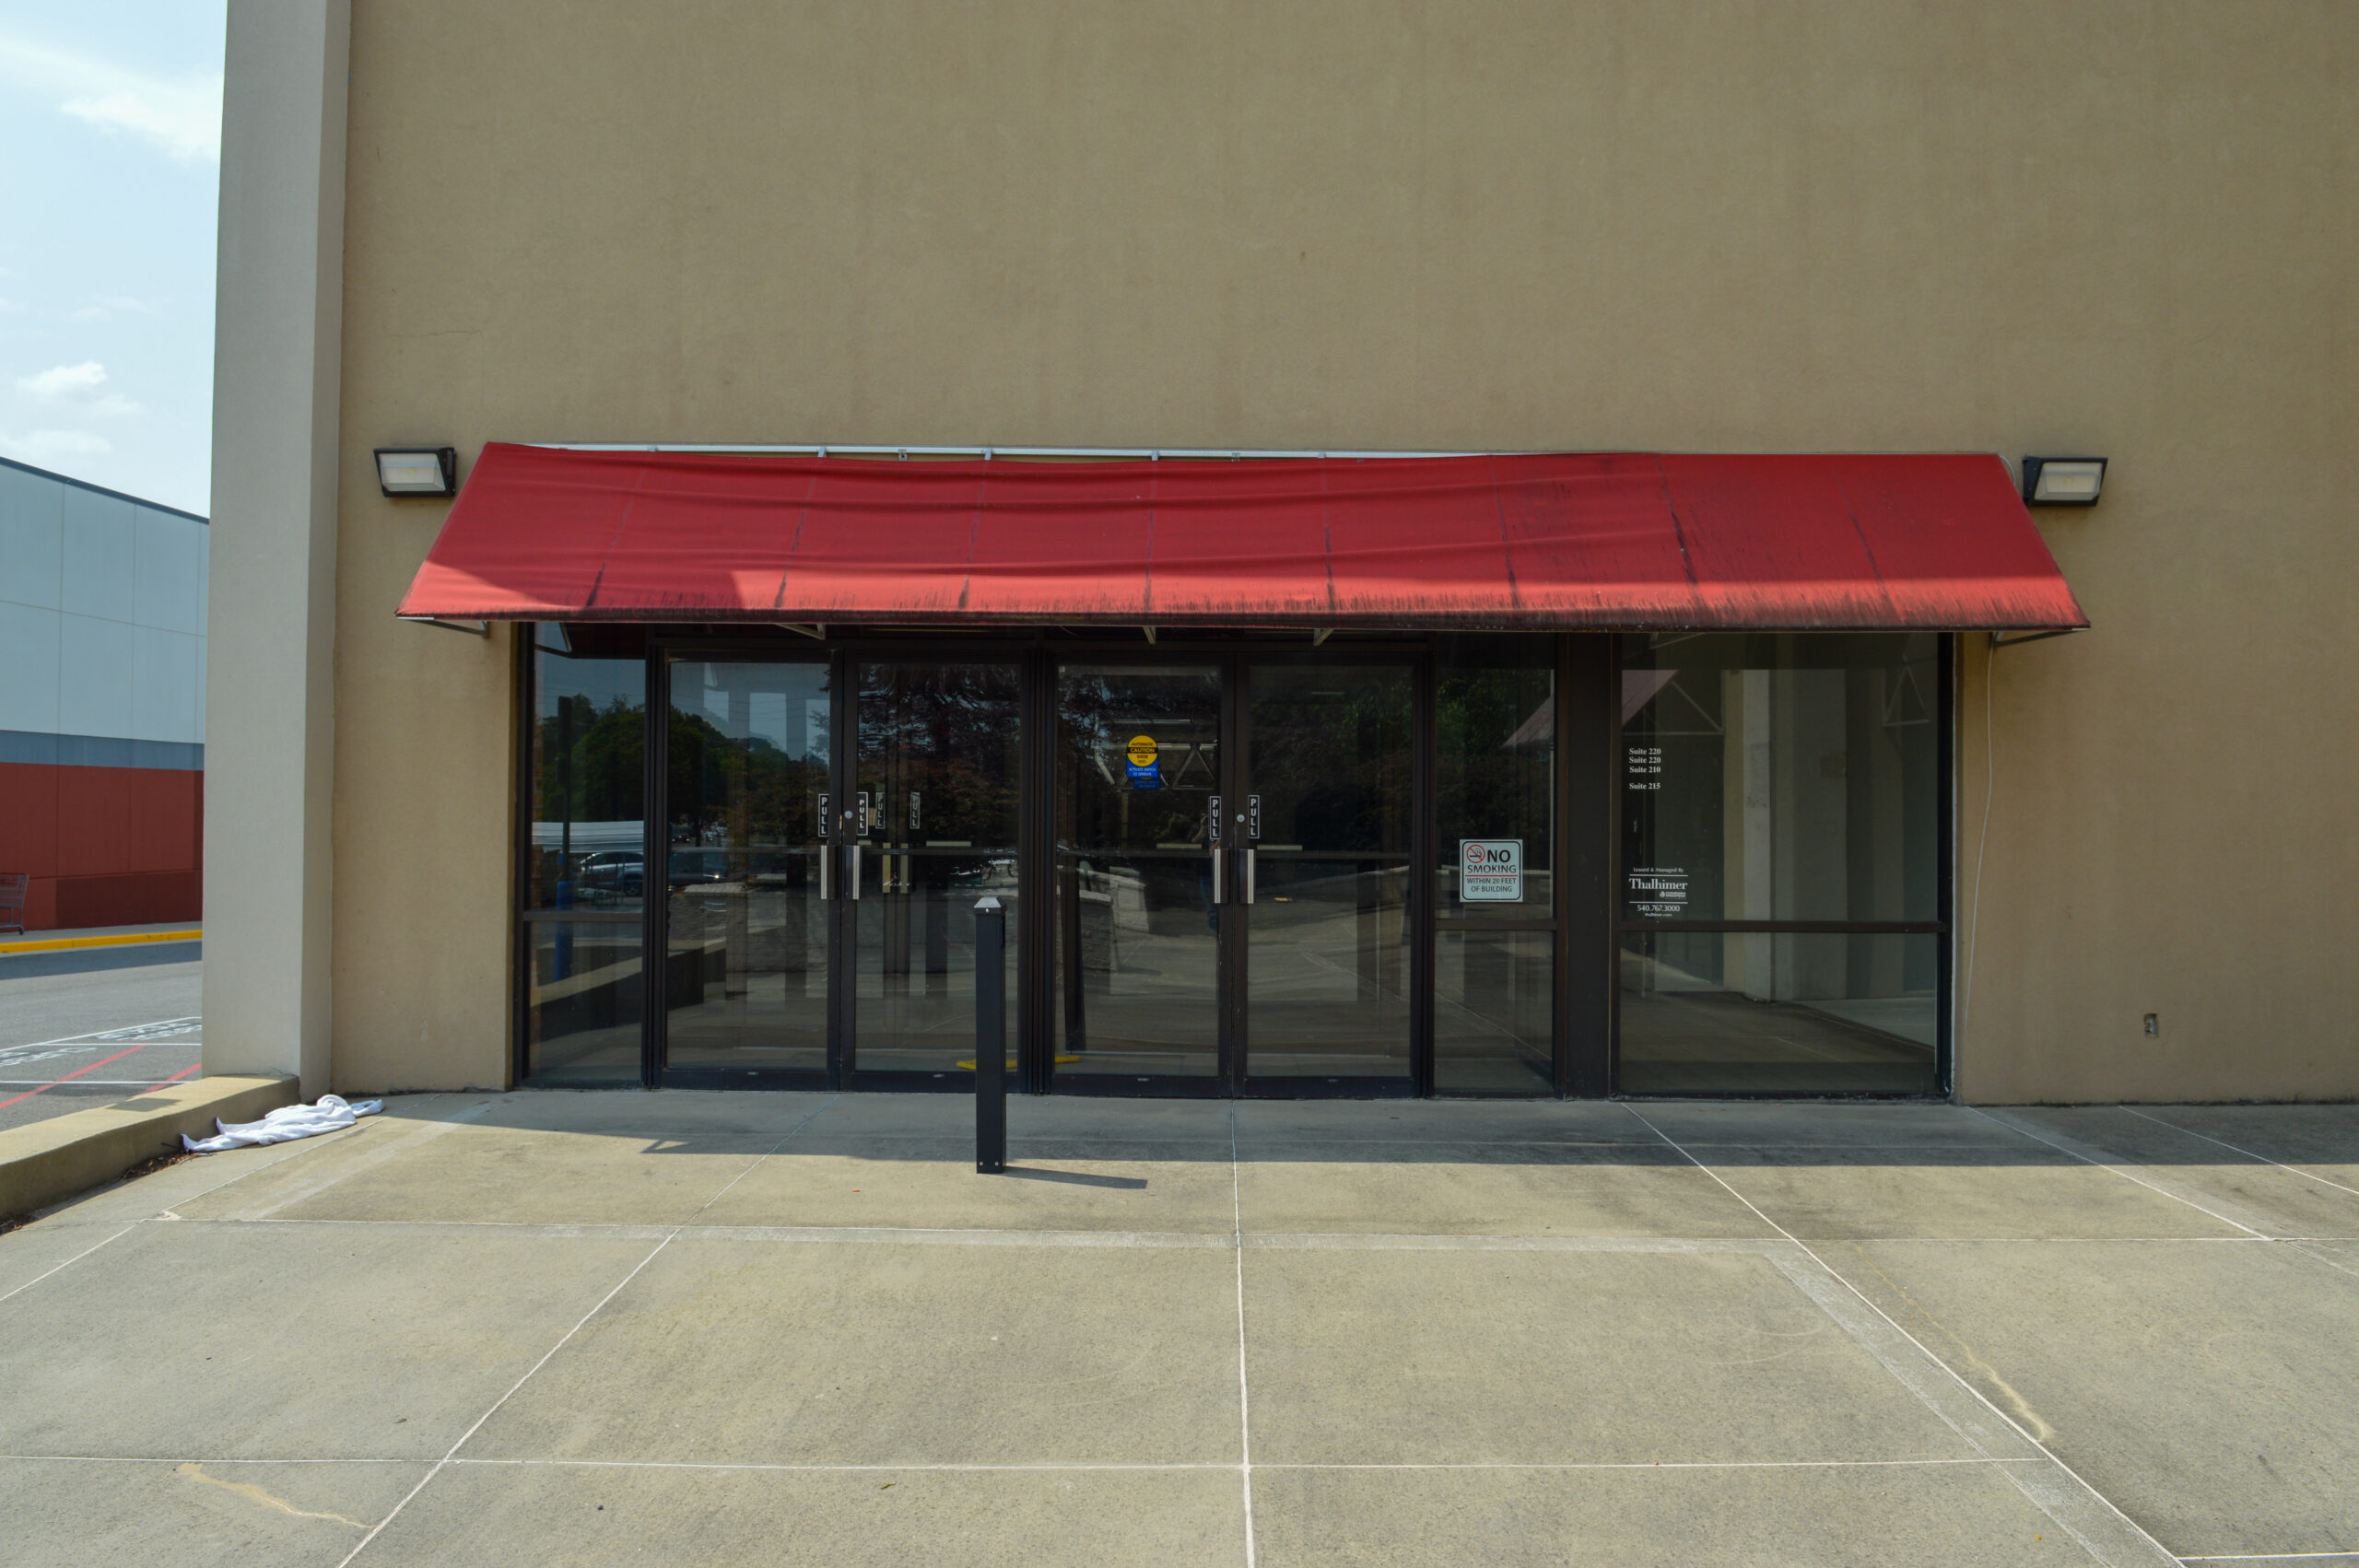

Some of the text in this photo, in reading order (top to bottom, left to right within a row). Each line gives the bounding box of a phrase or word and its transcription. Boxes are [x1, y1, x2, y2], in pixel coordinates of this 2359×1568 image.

[1487, 849, 1511, 863] NO
[1467, 864, 1517, 873] SMOKING
[1629, 878, 1688, 890] Thalhimer
